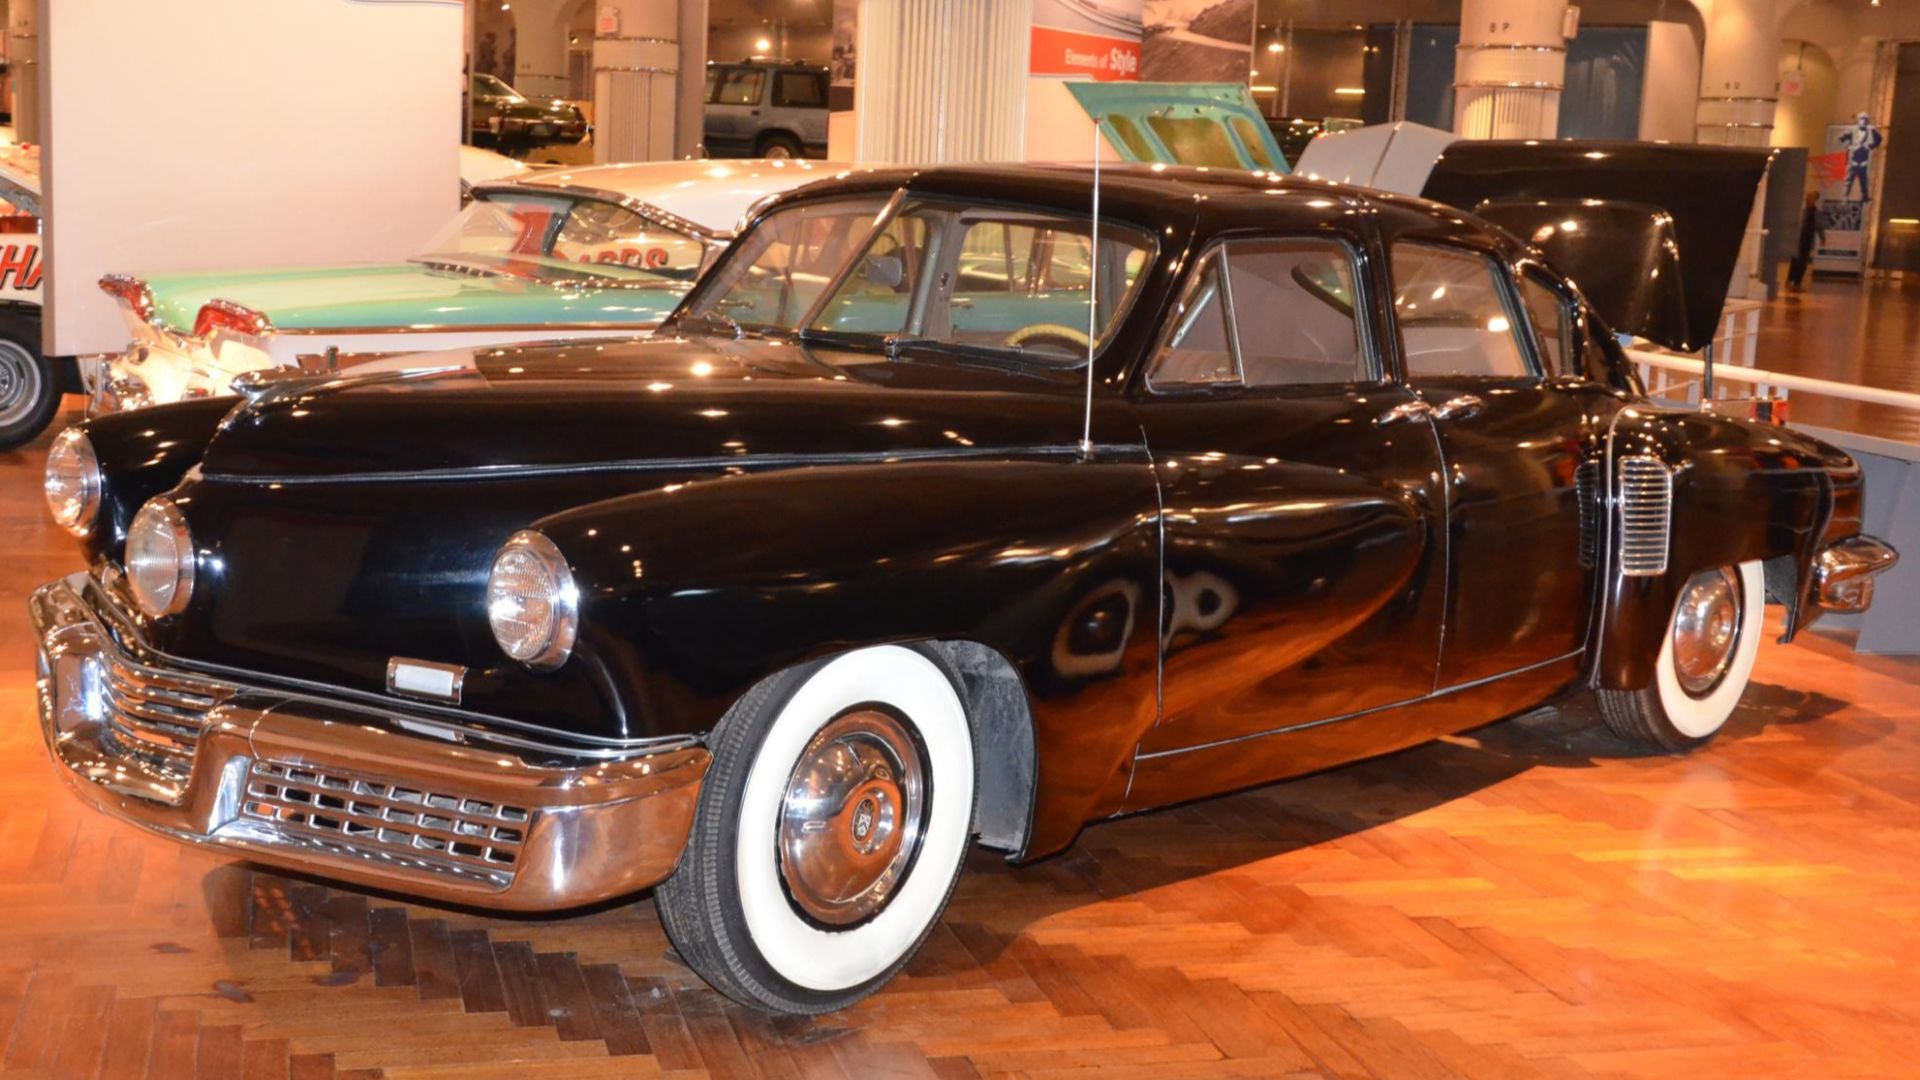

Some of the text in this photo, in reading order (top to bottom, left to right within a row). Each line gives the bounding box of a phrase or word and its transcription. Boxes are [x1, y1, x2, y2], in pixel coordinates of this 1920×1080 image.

[1064, 47, 1137, 76] Elements of Style
